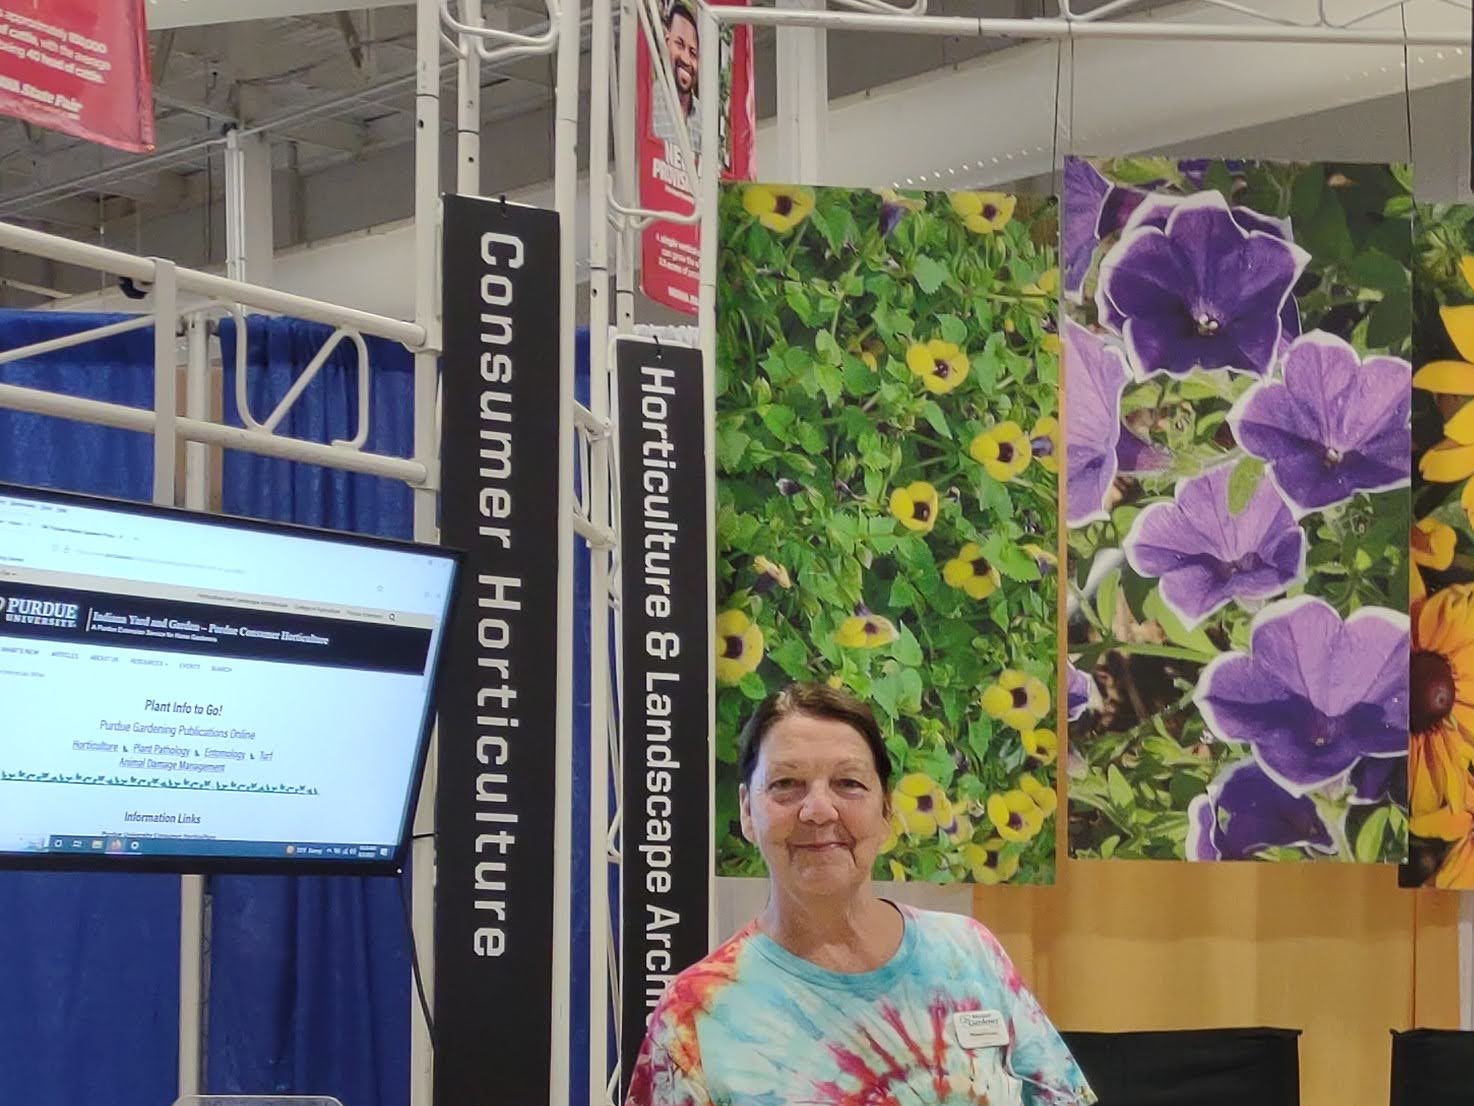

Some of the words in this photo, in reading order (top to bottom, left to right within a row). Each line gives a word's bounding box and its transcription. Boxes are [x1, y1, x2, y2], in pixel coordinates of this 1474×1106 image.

[479, 231, 526, 549] Consumer
[639, 366, 679, 617] Horticulture
[6, 598, 79, 620] PURDUE
[93, 611, 127, 624] Indiana
[5, 613, 77, 628] UNIVERSITY
[645, 630, 680, 660] &
[144, 699, 170, 713] Plant
[172, 702, 193, 715] Info
[194, 703, 205, 715] to
[206, 704, 223, 716] Go!
[99, 719, 132, 732] Purdue
[132, 721, 176, 737] Gardening
[179, 725, 229, 739] Publications
[230, 729, 256, 741] Online
[473, 574, 522, 957] Horticulture
[638, 671, 680, 893] Landscape
[124, 811, 176, 824] Information
[177, 813, 201, 824] Links
